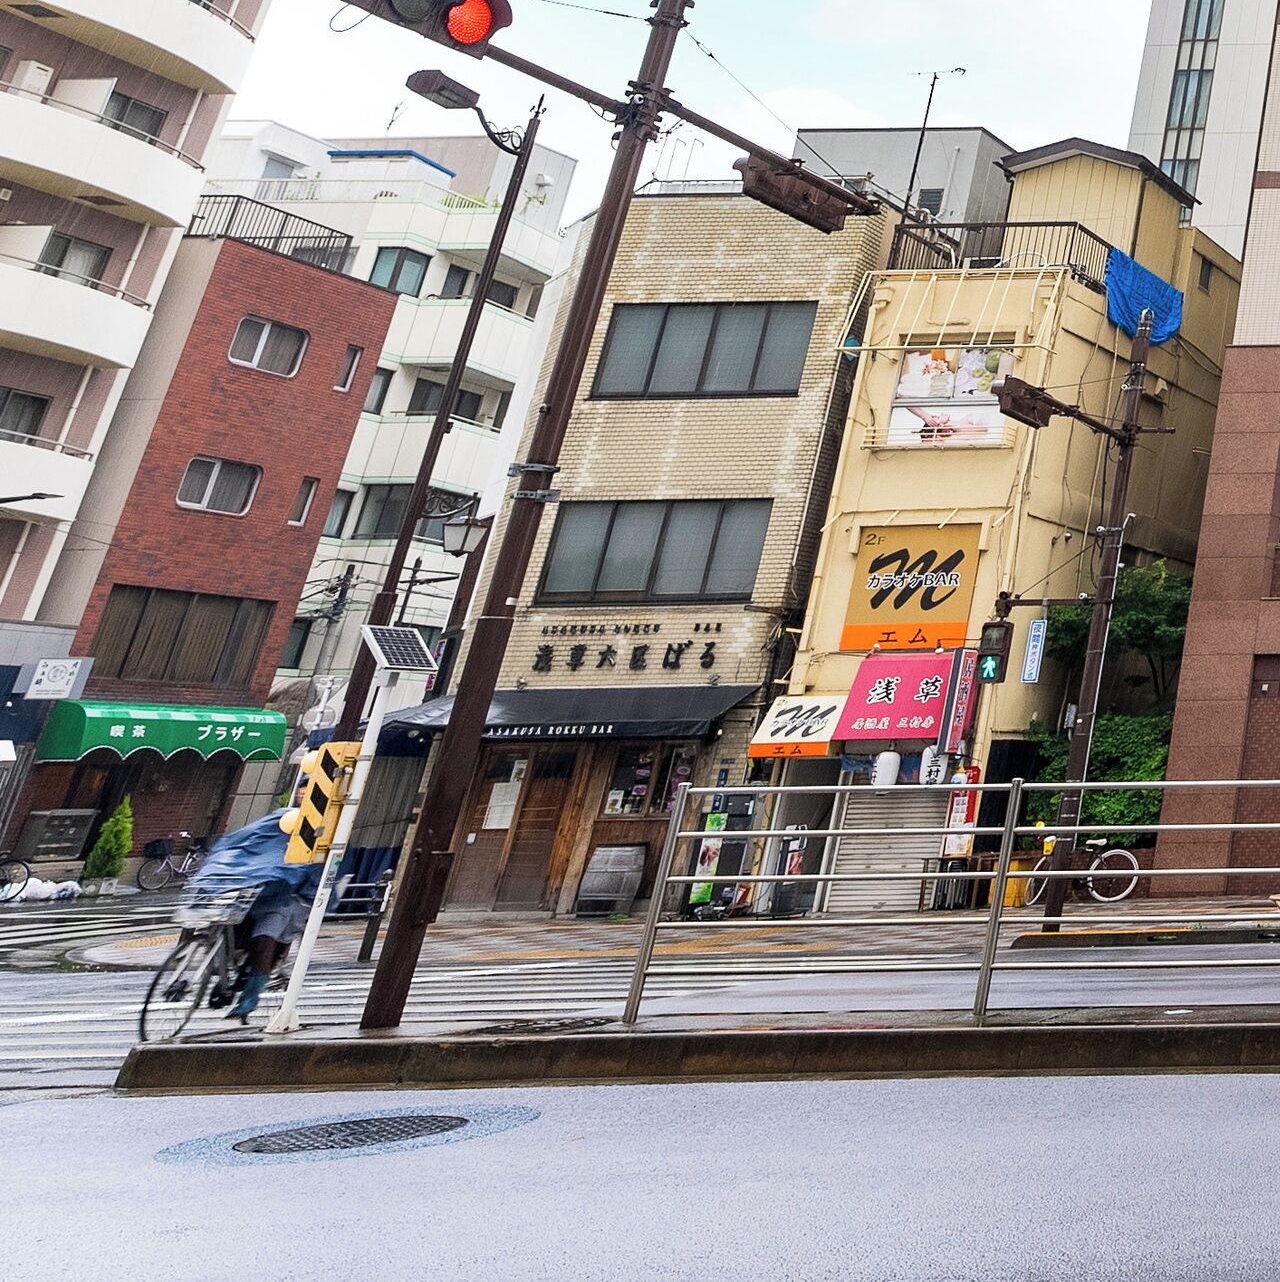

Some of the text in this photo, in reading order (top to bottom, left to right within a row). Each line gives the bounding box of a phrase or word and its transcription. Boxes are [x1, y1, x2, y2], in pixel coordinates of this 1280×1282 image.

[865, 533, 887, 546] 2F
[866, 571, 961, 591] カラオケBAR
[877, 628, 928, 644] エム
[866, 675, 944, 706] 浅草
[109, 724, 262, 741] 喫茶 ブラザー
[487, 724, 614, 736] ASAKUSA ROKKU BAR
